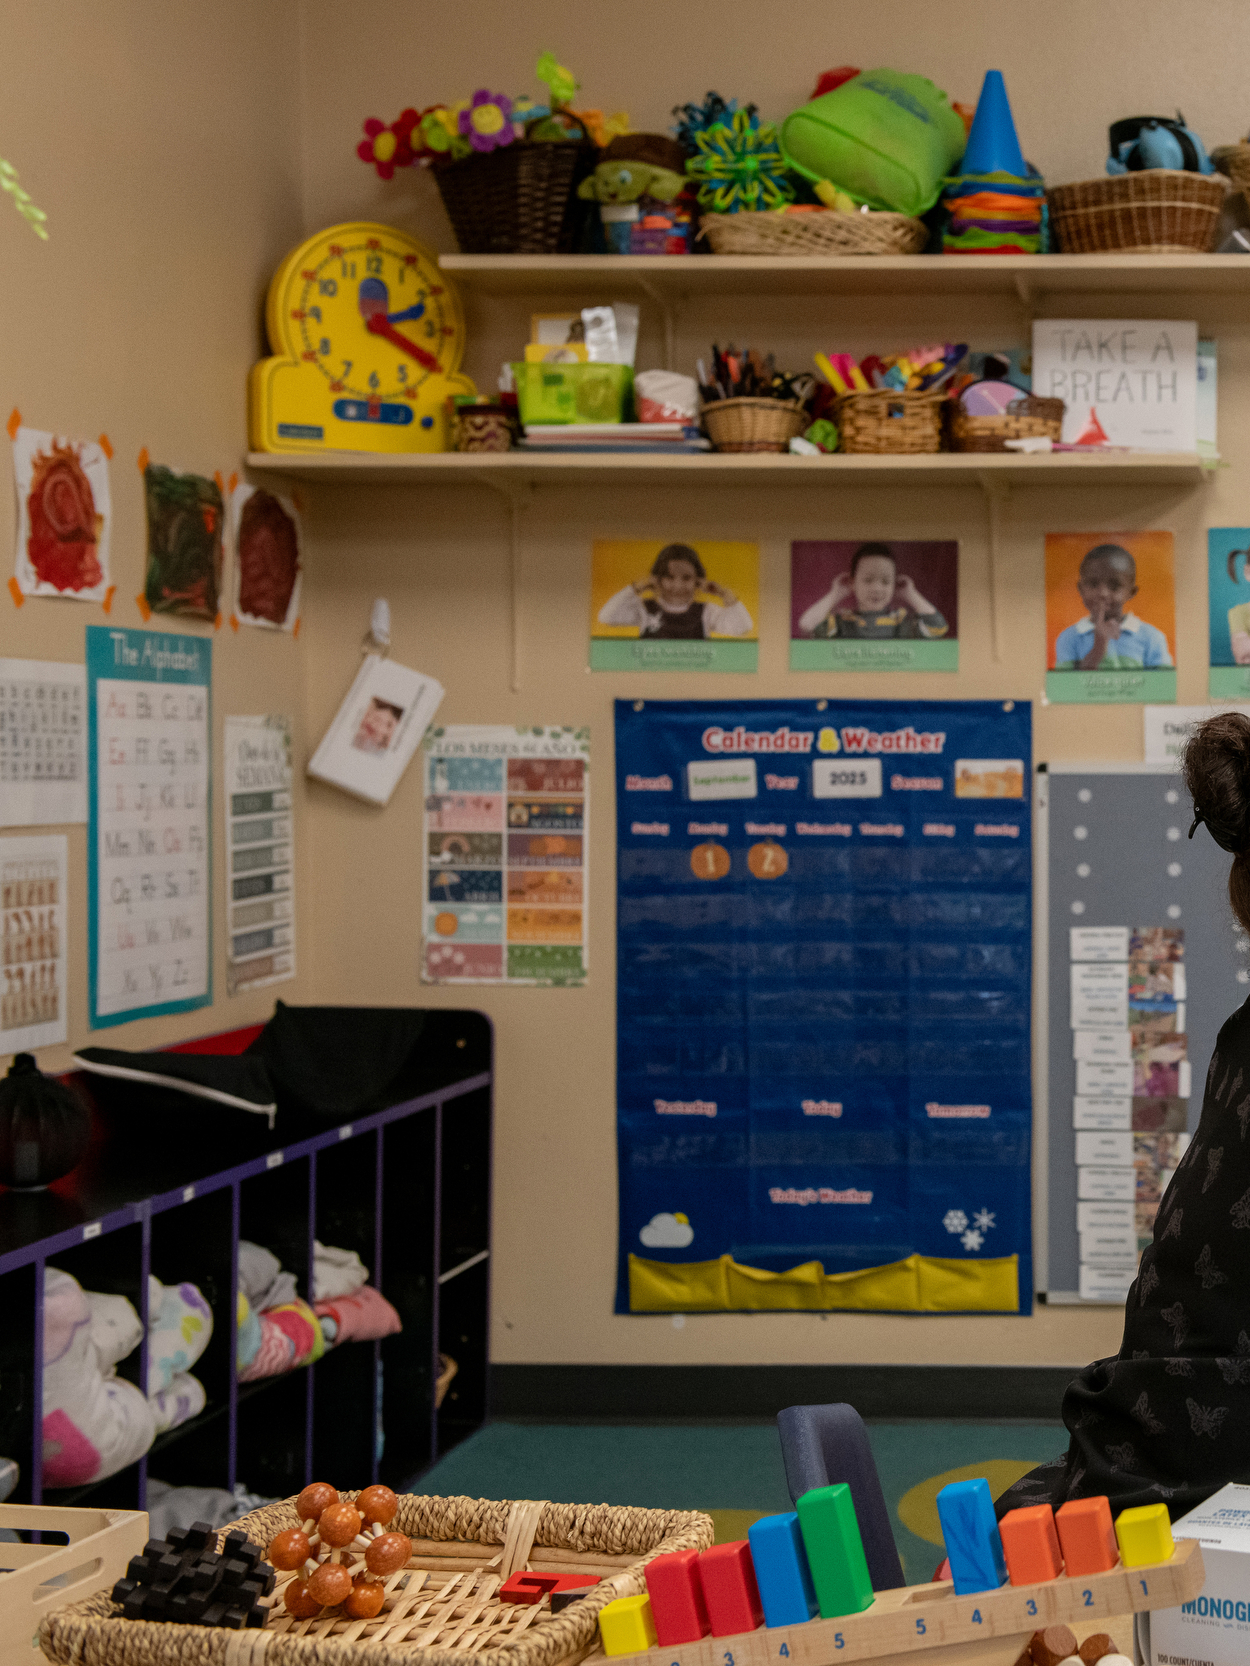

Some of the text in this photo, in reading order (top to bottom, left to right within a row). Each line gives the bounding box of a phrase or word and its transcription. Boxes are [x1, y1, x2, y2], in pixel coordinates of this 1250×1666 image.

[341, 260, 356, 279] 11
[366, 255, 383, 274] 12
[319, 278, 338, 297] 10
[1051, 329, 1175, 364] TAKE A
[1051, 369, 1178, 404] BREATH
[110, 632, 199, 681] The Alphabet
[702, 727, 813, 753] Calendar
[842, 727, 946, 753] Weather
[829, 771, 868, 787] 2025
[704, 847, 776, 875] 1 2
[723, 1580, 1149, 1666] 3 4 5 5 4 3 2 1
[1181, 1616, 1220, 1628] CLEANING
[1157, 1653, 1215, 1666] 100 COUNT/CUENTA
